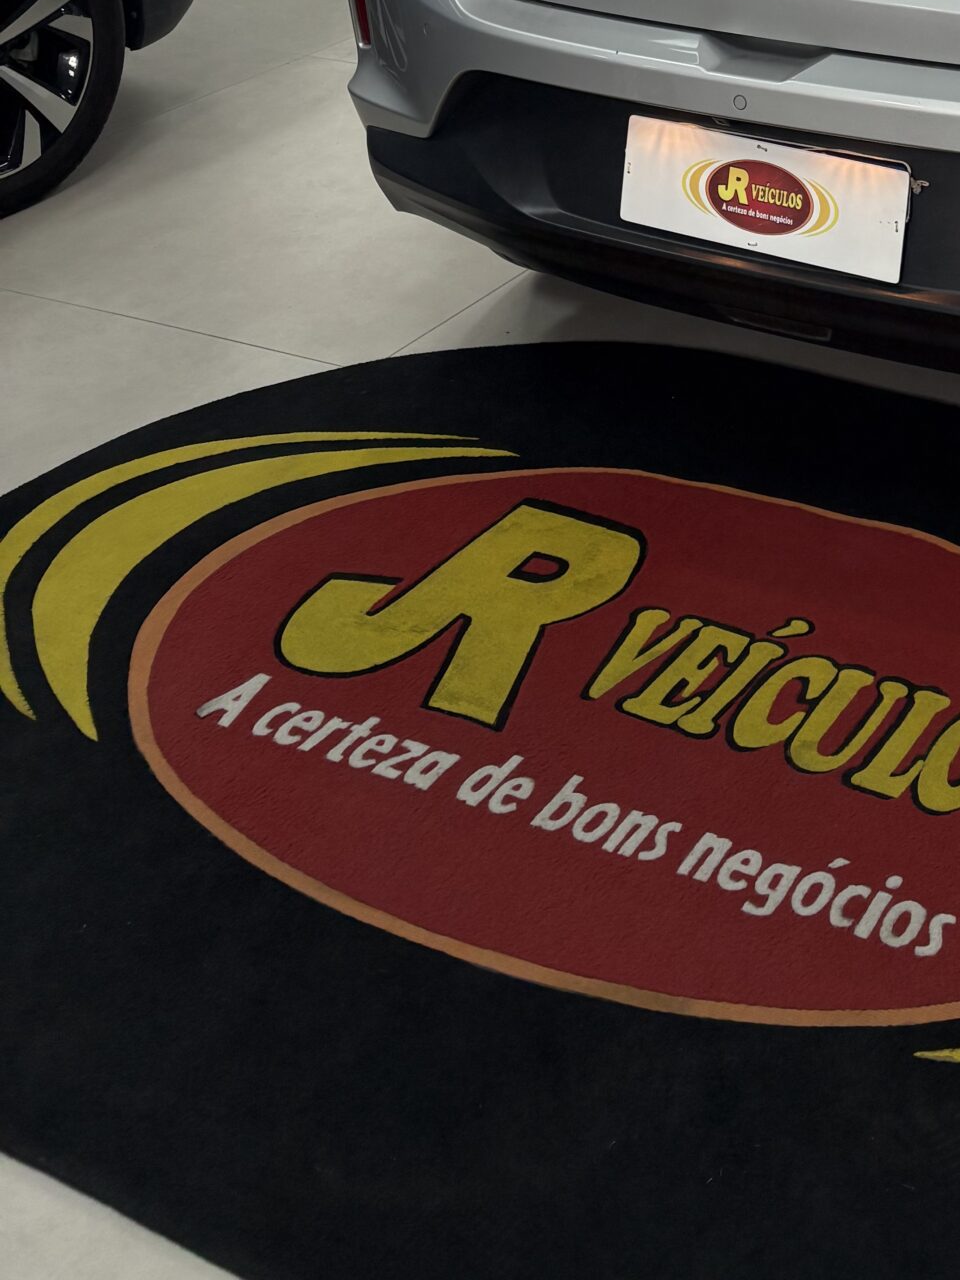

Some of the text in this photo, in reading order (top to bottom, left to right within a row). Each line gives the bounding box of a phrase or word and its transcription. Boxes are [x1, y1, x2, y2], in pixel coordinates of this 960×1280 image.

[717, 166, 803, 211] JR VEÍCULOS
[722, 202, 793, 226] A certeza de bons negócios
[274, 498, 647, 732] JR
[196, 673, 956, 957] A certeza de bons negócios
